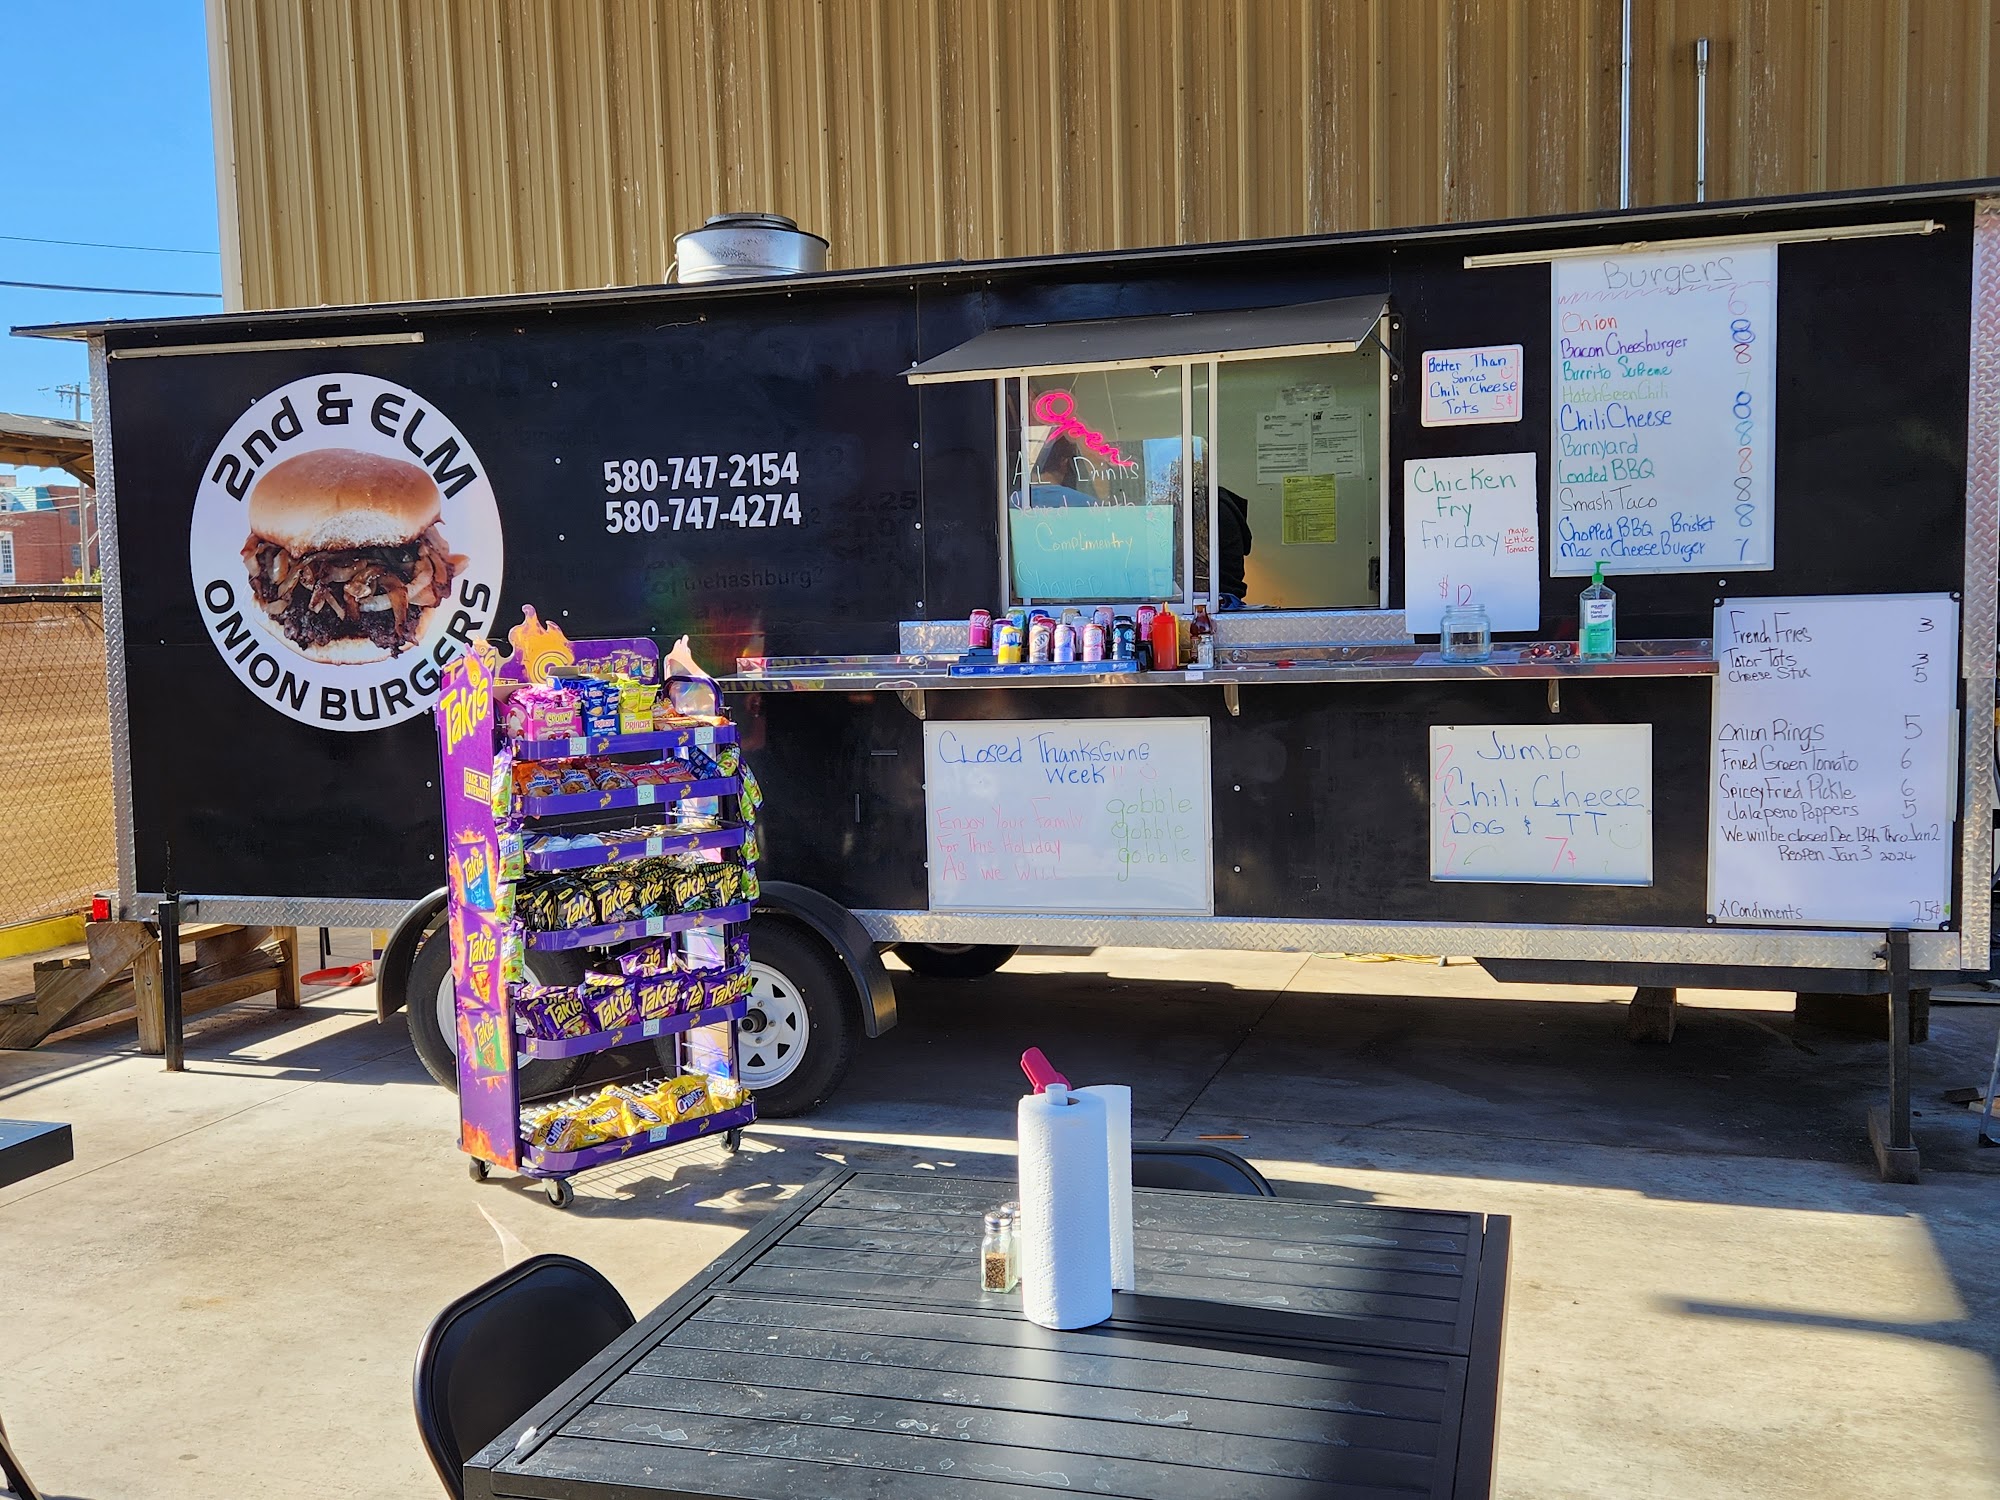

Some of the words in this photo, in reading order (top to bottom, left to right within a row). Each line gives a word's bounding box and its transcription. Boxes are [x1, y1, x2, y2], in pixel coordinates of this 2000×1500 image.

[1603, 256, 1734, 295] Burgers
[1562, 312, 1617, 332] Onion
[1728, 290, 1747, 315] 6
[1561, 338, 1605, 359] Bacon
[1730, 318, 1756, 343] 8
[1428, 357, 1462, 373] Better
[1470, 353, 1506, 367] Than
[1562, 361, 1611, 380] Burrito
[1733, 343, 1752, 364] 8
[1430, 381, 1460, 398] Chili
[1470, 381, 1518, 394] Cheese
[1442, 399, 1479, 414] Tots
[1560, 404, 1606, 431] Chili
[1607, 402, 1672, 428] Cheese
[1733, 391, 1752, 420] 8
[211, 396, 303, 501] 2nd
[317, 384, 353, 425] &
[370, 393, 478, 500] ELM
[1560, 433, 1638, 460] Barnyard
[1735, 420, 1753, 446] 8
[603, 452, 799, 494] 580-747-2154
[1559, 459, 1608, 484] Loaded
[1611, 458, 1656, 481] BBQ
[1737, 447, 1753, 474] 8
[1437, 496, 1472, 527] Fry
[1560, 487, 1613, 512] Smash
[1610, 485, 1658, 511] Taco
[1734, 476, 1753, 502] 8
[605, 492, 802, 534] 580-747-4274
[1617, 516, 1653, 538] BBQ
[1670, 511, 1716, 533] Brisket
[1734, 503, 1754, 527] 8
[1421, 520, 1500, 557] Friday
[1505, 545, 1535, 554] Tomato
[1610, 538, 1660, 558] Cheese
[1660, 530, 1706, 563] Burger
[1734, 538, 1750, 561] 7
[1774, 612, 1812, 643] Fries
[1918, 617, 1934, 633] 3
[204, 579, 310, 711] ONION
[320, 579, 491, 722] BURGERS
[1760, 646, 1797, 667] Tots
[1911, 653, 1929, 668] 3
[1728, 670, 1772, 683] Cheese
[1914, 666, 1928, 683] 5
[441, 678, 488, 755] Takis
[1718, 723, 1767, 741] Onion
[1772, 718, 1825, 752] Rings
[1904, 714, 1923, 740] 5
[1477, 730, 1581, 760] Jumbo
[1720, 748, 1758, 770] Fried
[1760, 744, 1808, 771] Green
[1801, 745, 1860, 771] Tomato
[1900, 748, 1913, 770] 6
[1443, 766, 1519, 808] Chili
[1532, 771, 1645, 808] Cheese
[1720, 773, 1764, 809] Spicey
[1764, 777, 1803, 799] Fried
[1807, 772, 1856, 800] Pickle
[1900, 779, 1915, 797] 6
[936, 806, 985, 830] Enjoy
[992, 804, 1025, 829] Your
[1032, 797, 1083, 829] Family
[1106, 788, 1193, 828] gobble
[1727, 801, 1798, 827] Jalapeno
[1800, 801, 1859, 824] Poppers
[1902, 799, 1917, 818] 5
[936, 834, 959, 852] For
[962, 832, 996, 854] This
[1111, 815, 1190, 848] gobble
[1721, 825, 1745, 842] We
[1788, 828, 1827, 842] closed
[1830, 825, 1854, 842] Dec
[1908, 823, 1931, 841] Jan
[1930, 823, 1941, 841] 2
[462, 853, 484, 888] Takis
[943, 854, 968, 881] As
[1118, 842, 1196, 882] gobble
[1829, 846, 1859, 862] Jan
[1860, 845, 1873, 860] 3
[1880, 851, 1916, 861] 2024
[597, 886, 634, 922] Takis
[639, 879, 663, 908] akis
[1719, 899, 1730, 917] X
[1731, 900, 1803, 920] Condiments
[466, 931, 496, 967] Takis
[638, 982, 679, 1018] Takis
[709, 974, 743, 1008] Takis
[545, 999, 583, 1030] Takis
[593, 989, 633, 1032] Takis
[474, 1018, 495, 1052] Takis
